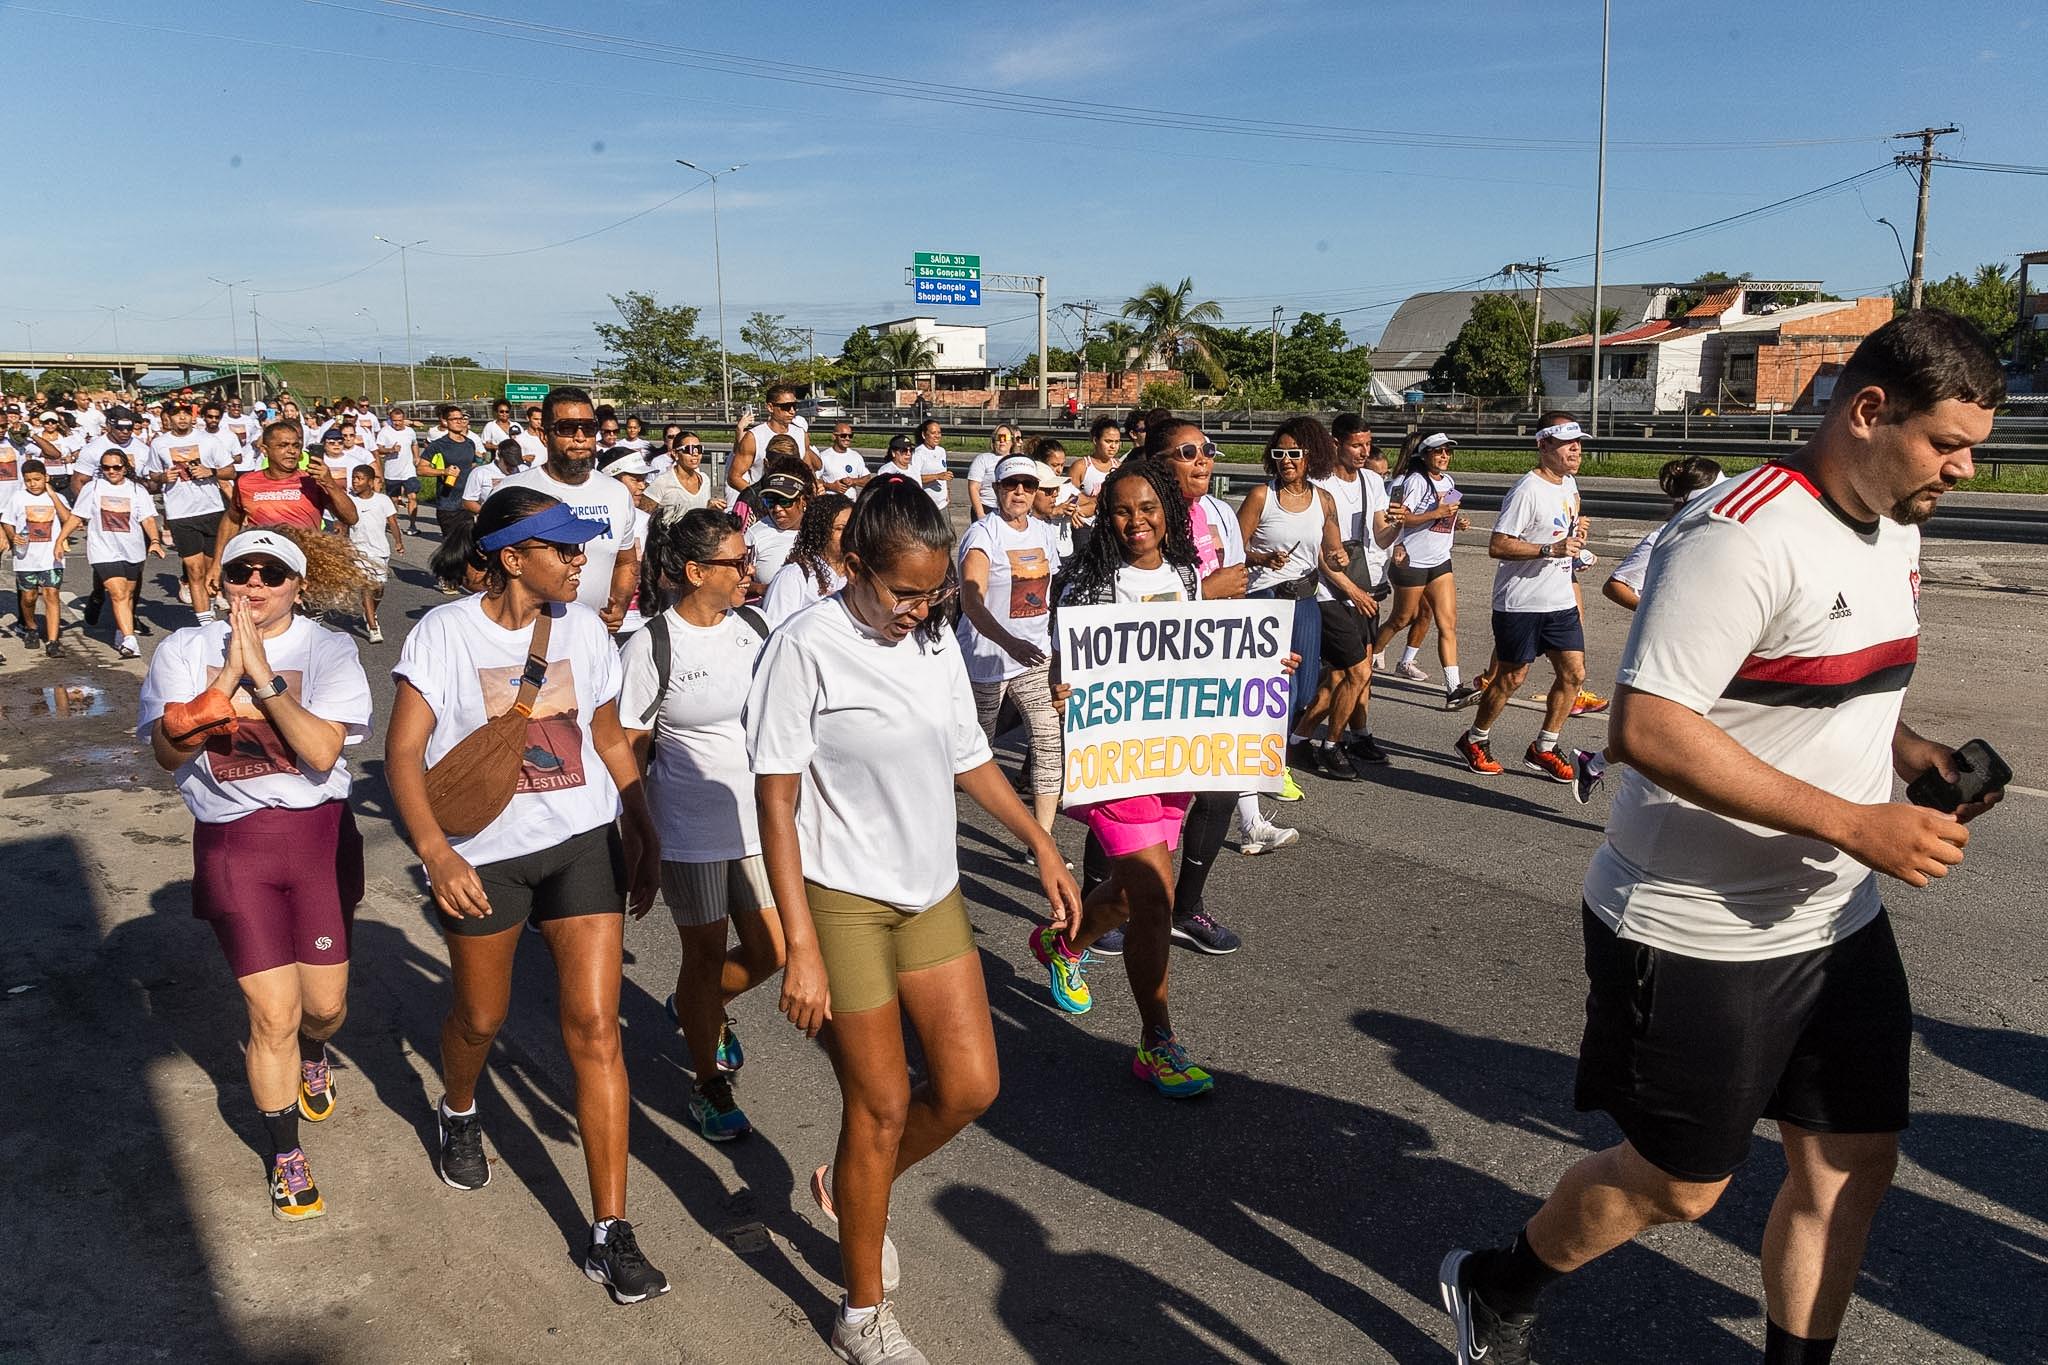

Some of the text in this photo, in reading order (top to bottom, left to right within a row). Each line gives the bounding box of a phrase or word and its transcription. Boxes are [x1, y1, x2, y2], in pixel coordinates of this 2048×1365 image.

[930, 254, 966, 265] SAÍDA 313
[920, 267, 966, 278] São Gonçalo
[920, 282, 966, 292] São Gonçalo
[918, 292, 966, 303] Shopping Rio
[1828, 609, 1852, 620] adidas
[1069, 615, 1280, 670] MOTORISTAS
[679, 671, 709, 682] VERA
[516, 773, 581, 791] ELESTINO
